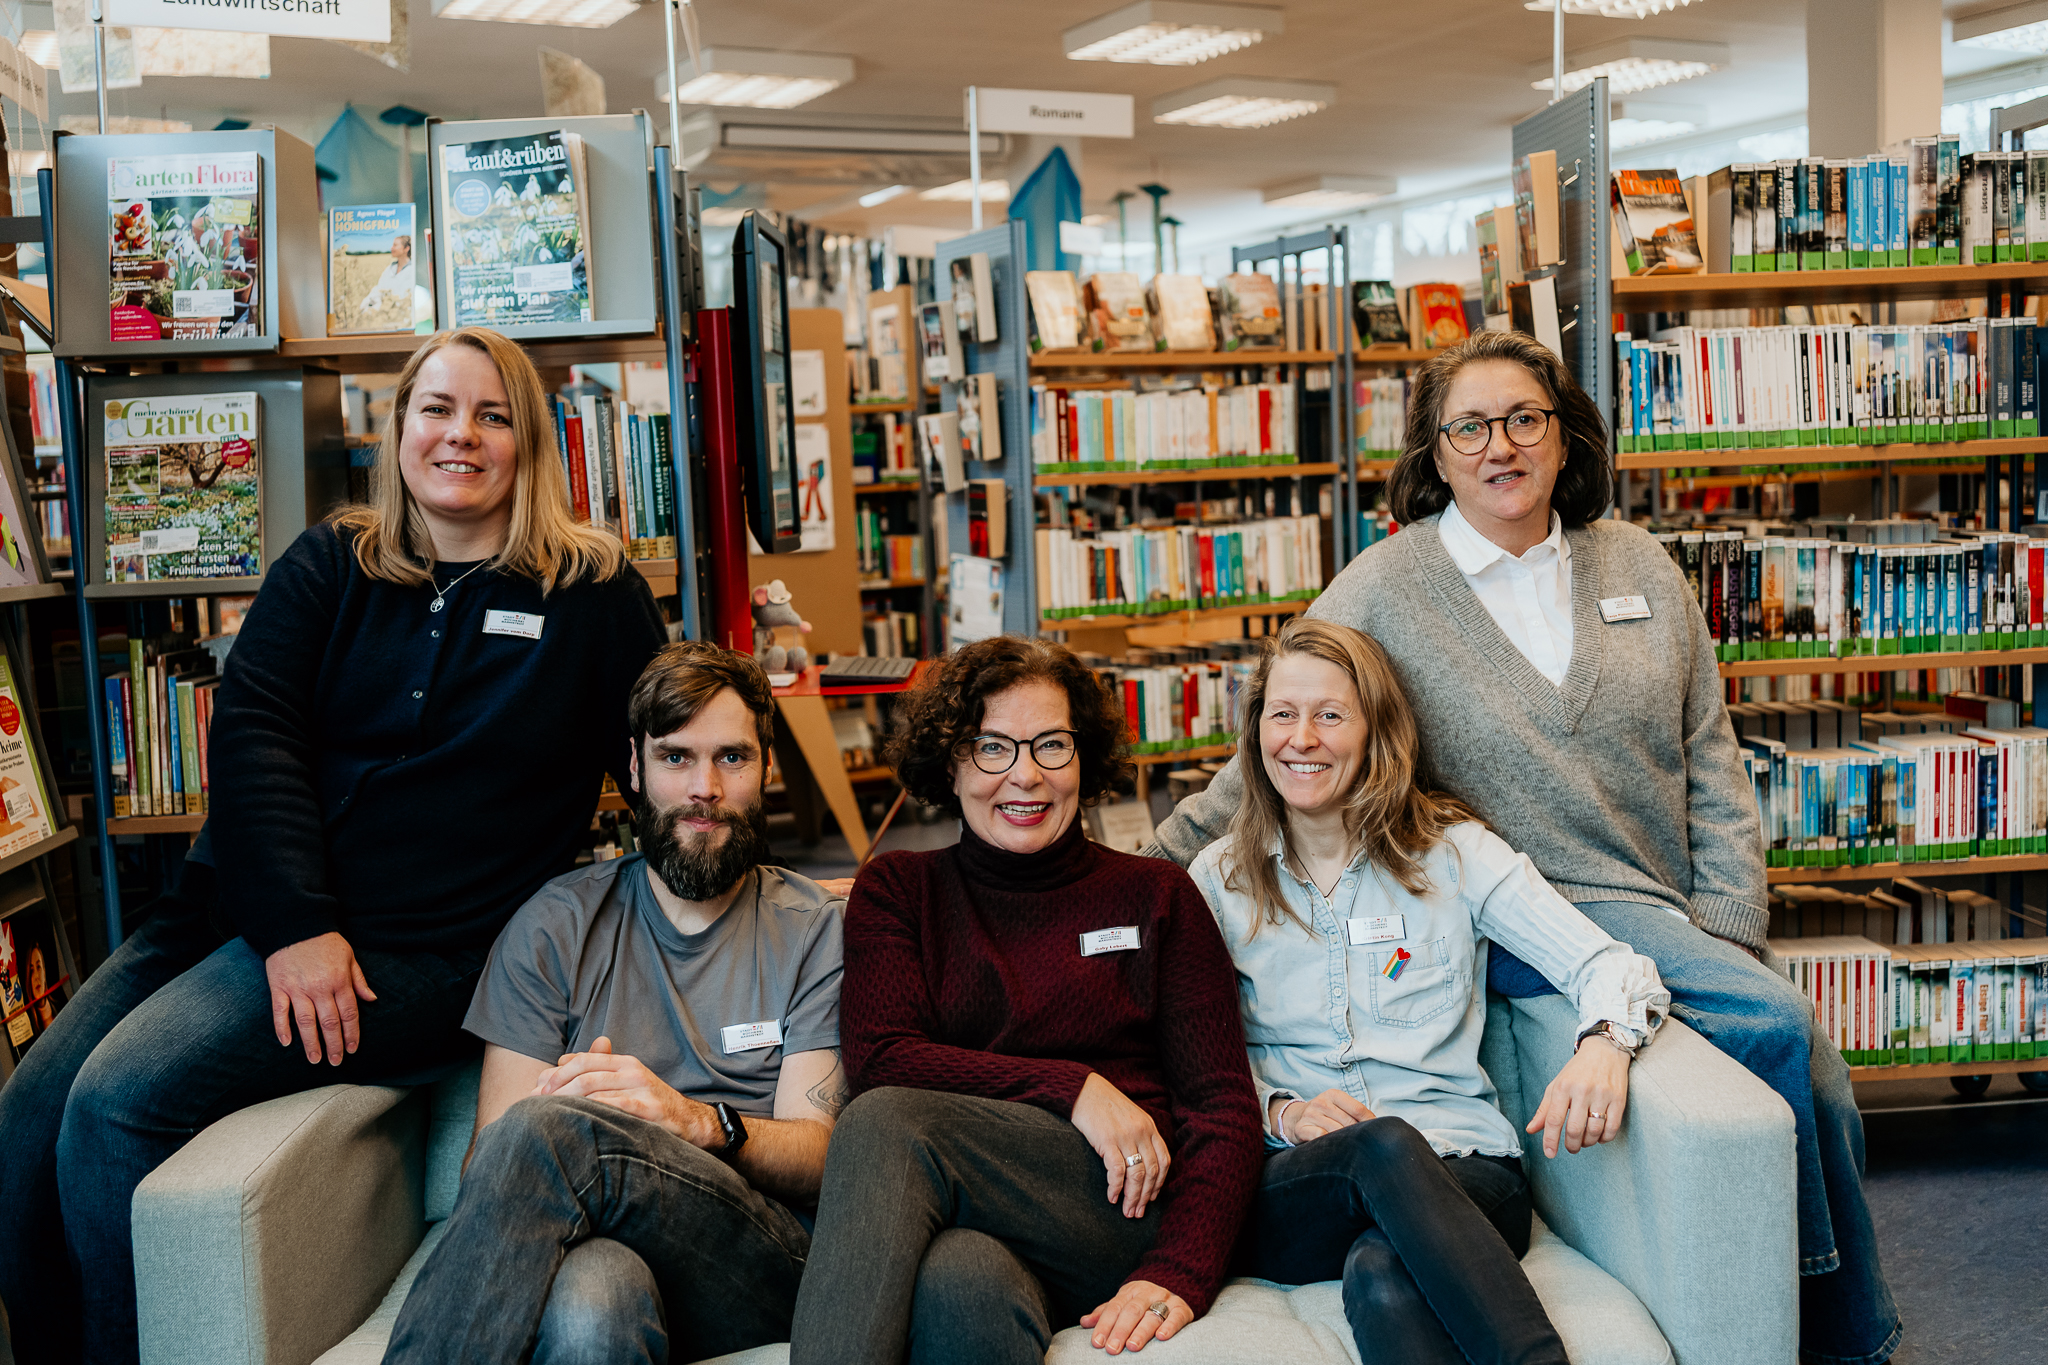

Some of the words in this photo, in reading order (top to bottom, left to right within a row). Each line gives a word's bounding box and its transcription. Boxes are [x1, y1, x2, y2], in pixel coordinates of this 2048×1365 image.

[1029, 105, 1084, 120] Romane
[451, 140, 567, 174] raut&rüben
[335, 211, 355, 222] DIE
[334, 219, 400, 233] HONIGFRAU
[460, 285, 476, 296] Wir
[478, 283, 502, 295] rufen
[461, 296, 486, 311] auf
[487, 294, 516, 309] den
[518, 292, 550, 306] Plan
[161, 321, 173, 329] Wir
[173, 320, 195, 329] freuen
[220, 320, 234, 328] den
[121, 400, 252, 438] Garten
[135, 409, 157, 417] mein
[657, 494, 665, 516] MEIN
[181, 554, 196, 565] die
[199, 554, 230, 564] ersten
[169, 564, 242, 577] Frühlingsboten
[1712, 571, 1722, 639] NEBELOPFE
[1978, 984, 1989, 1012] Eisige
[1979, 1014, 1989, 1032] Flut
